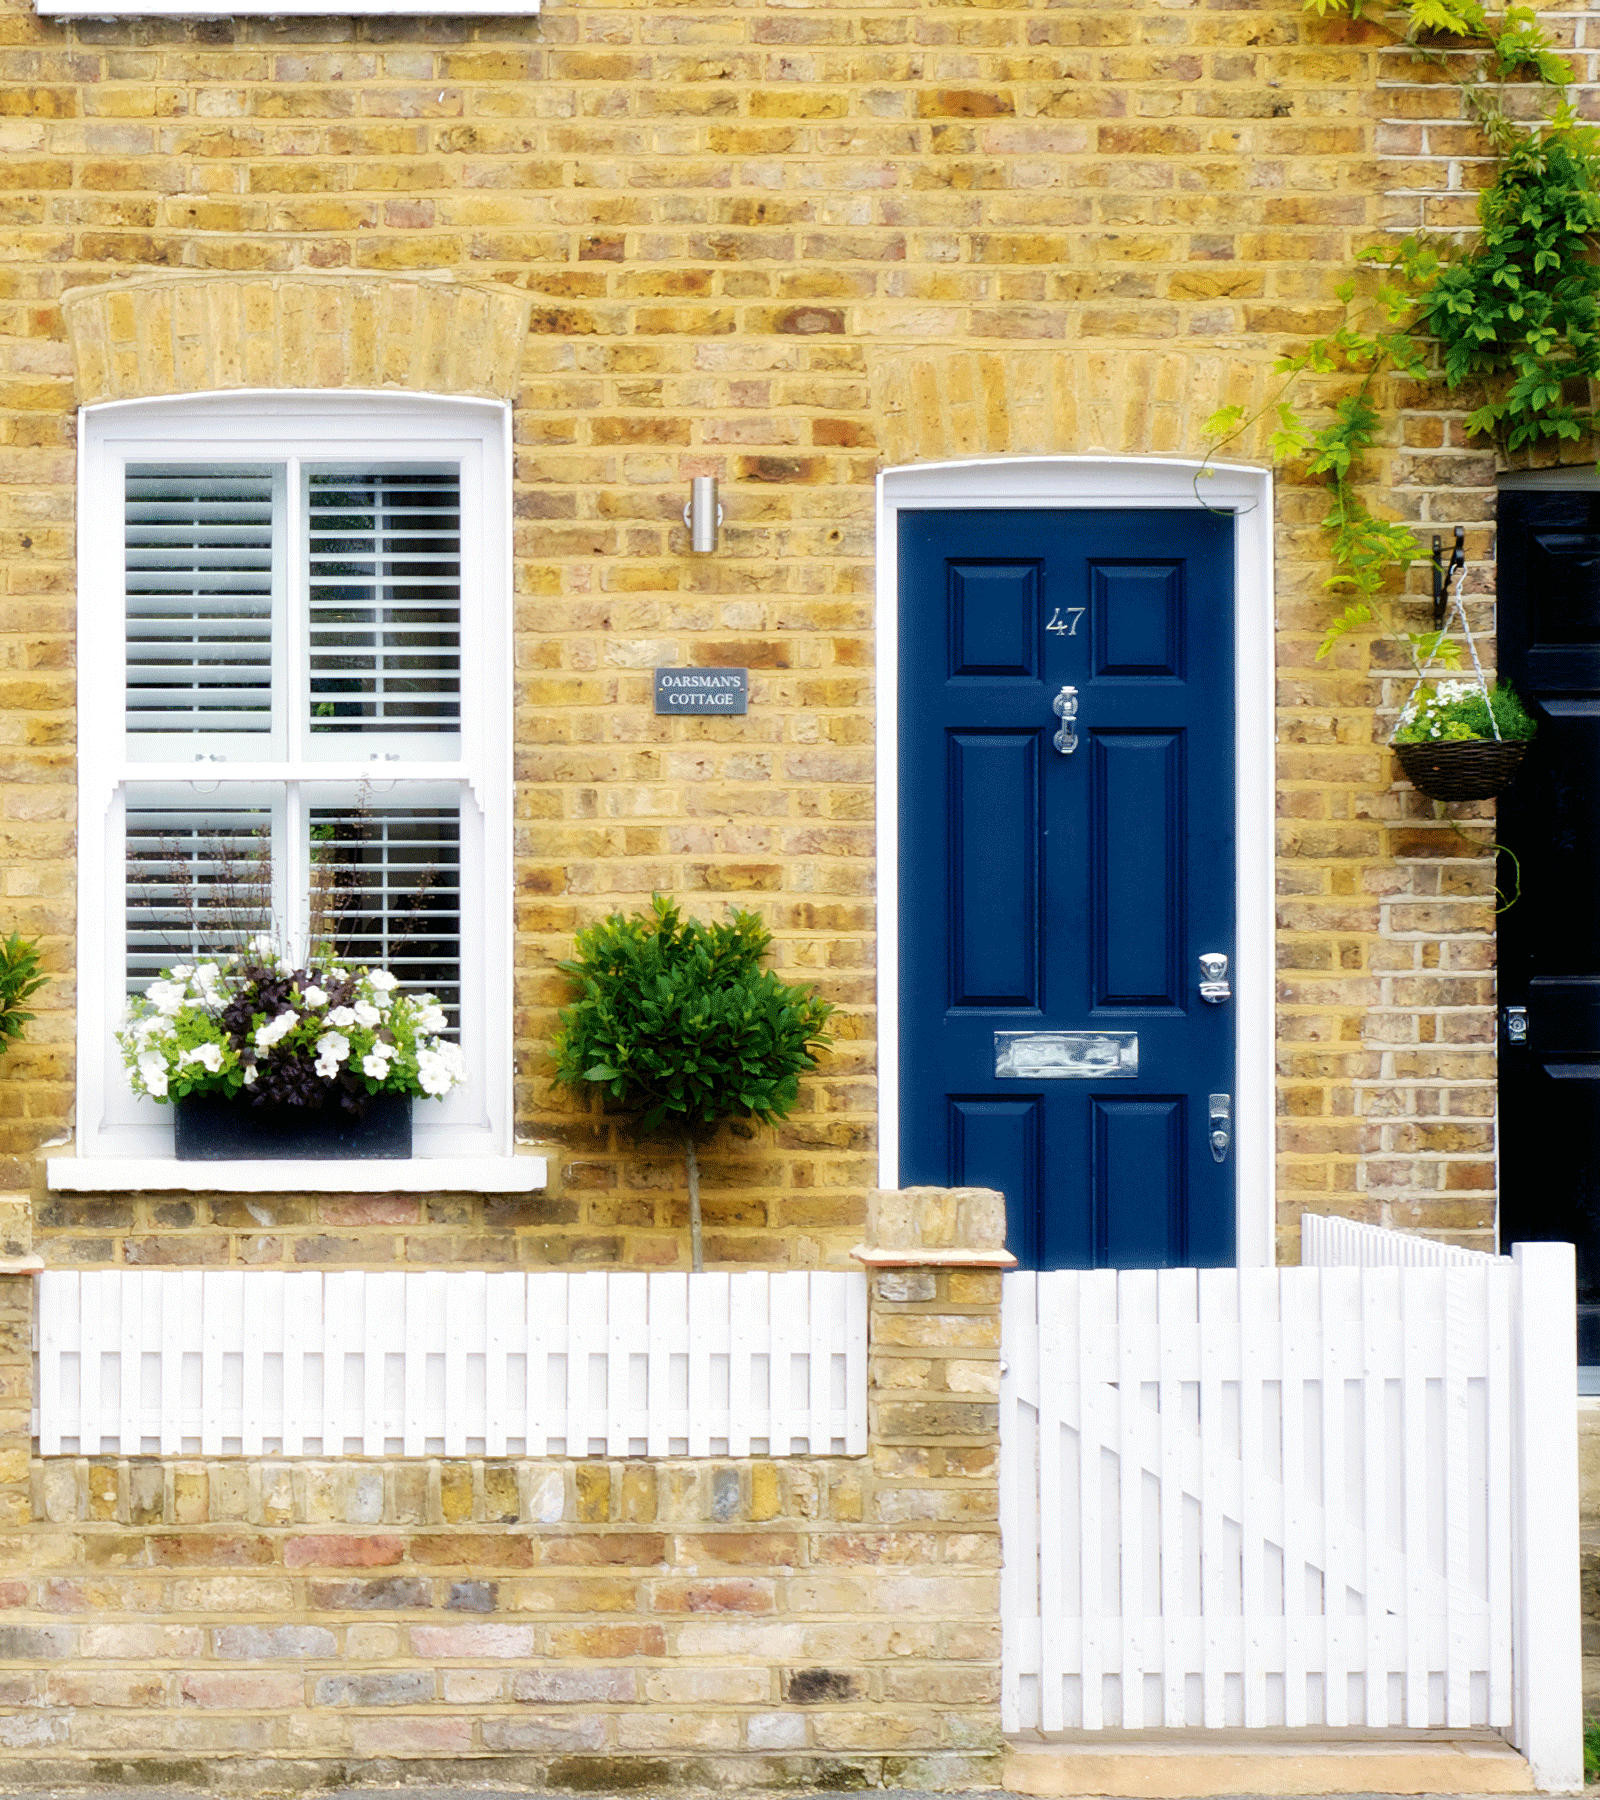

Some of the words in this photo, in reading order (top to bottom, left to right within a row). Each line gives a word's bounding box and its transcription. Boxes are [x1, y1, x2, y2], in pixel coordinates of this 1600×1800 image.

[1045, 607, 1086, 635] 47
[661, 675, 741, 687] OARSMAN'S
[669, 693, 734, 705] COTTAGE
